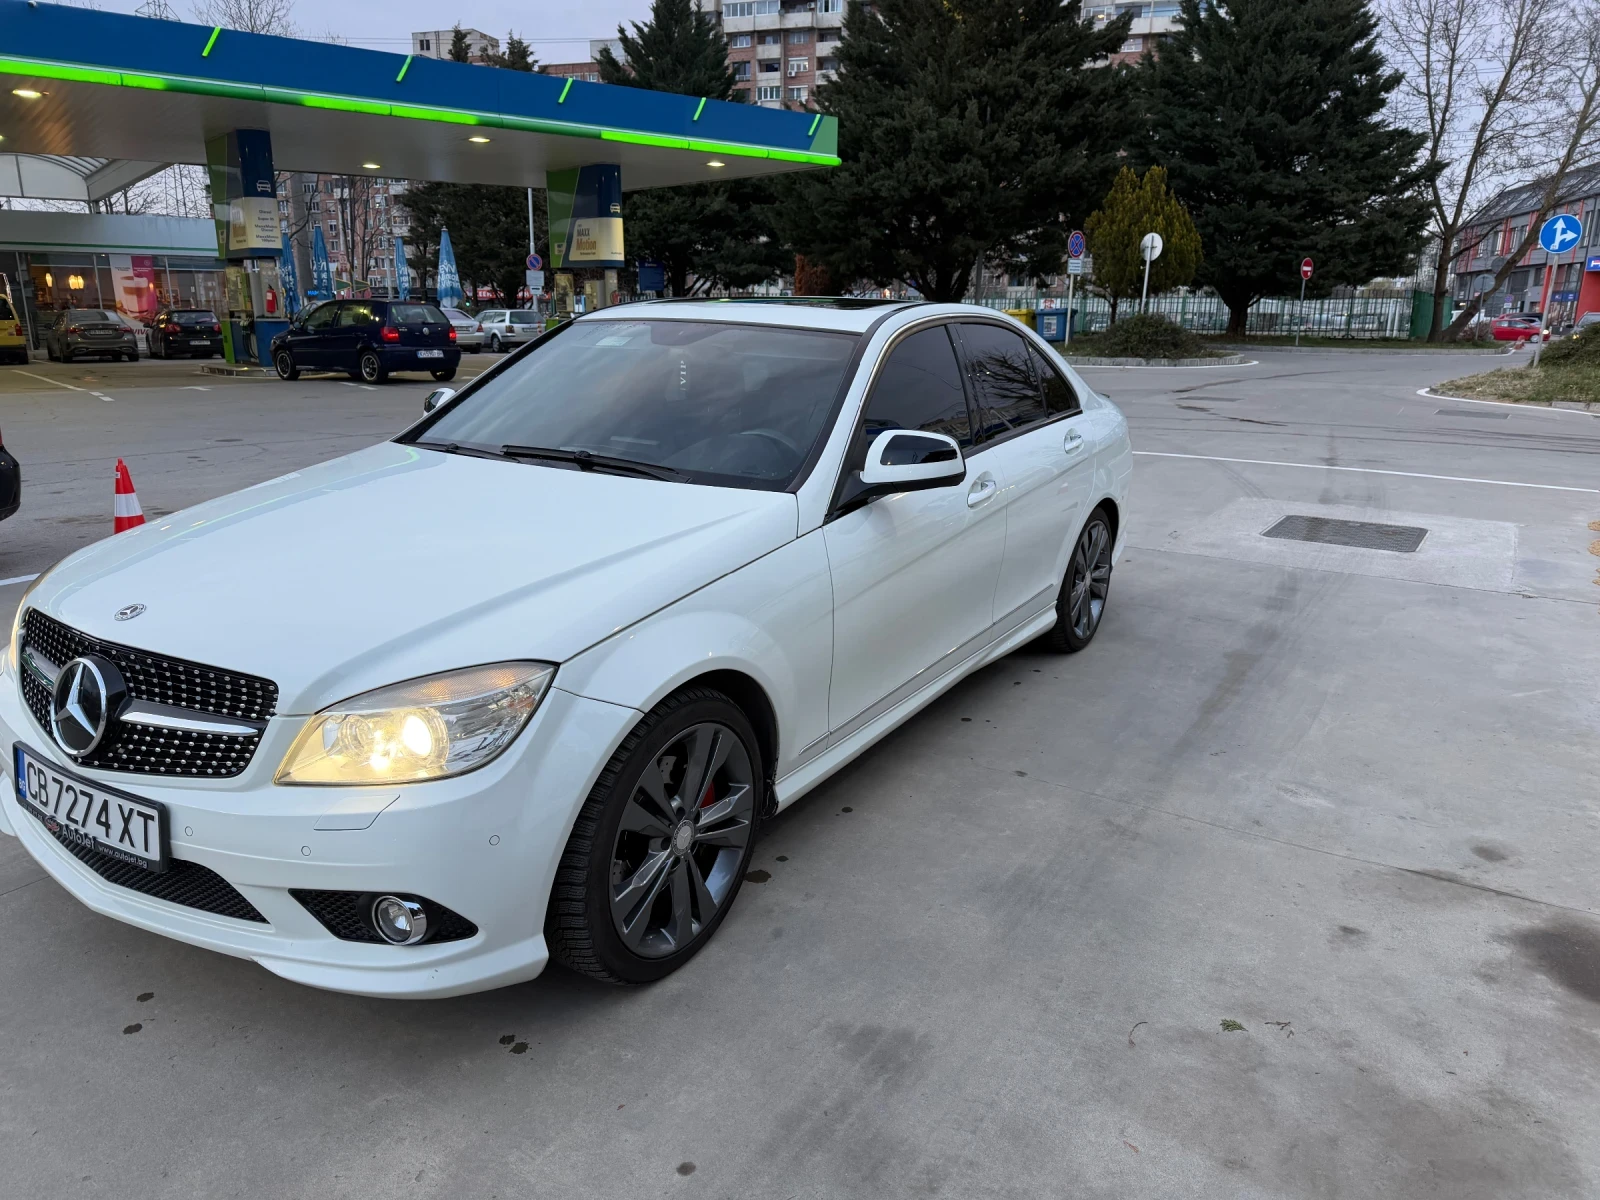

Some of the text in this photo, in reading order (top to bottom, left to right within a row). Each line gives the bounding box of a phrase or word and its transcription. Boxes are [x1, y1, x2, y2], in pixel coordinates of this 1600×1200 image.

[576, 238, 596, 251] Motion
[18, 777, 26, 792] BG
[98, 845, 148, 868] www.autojet.bg
